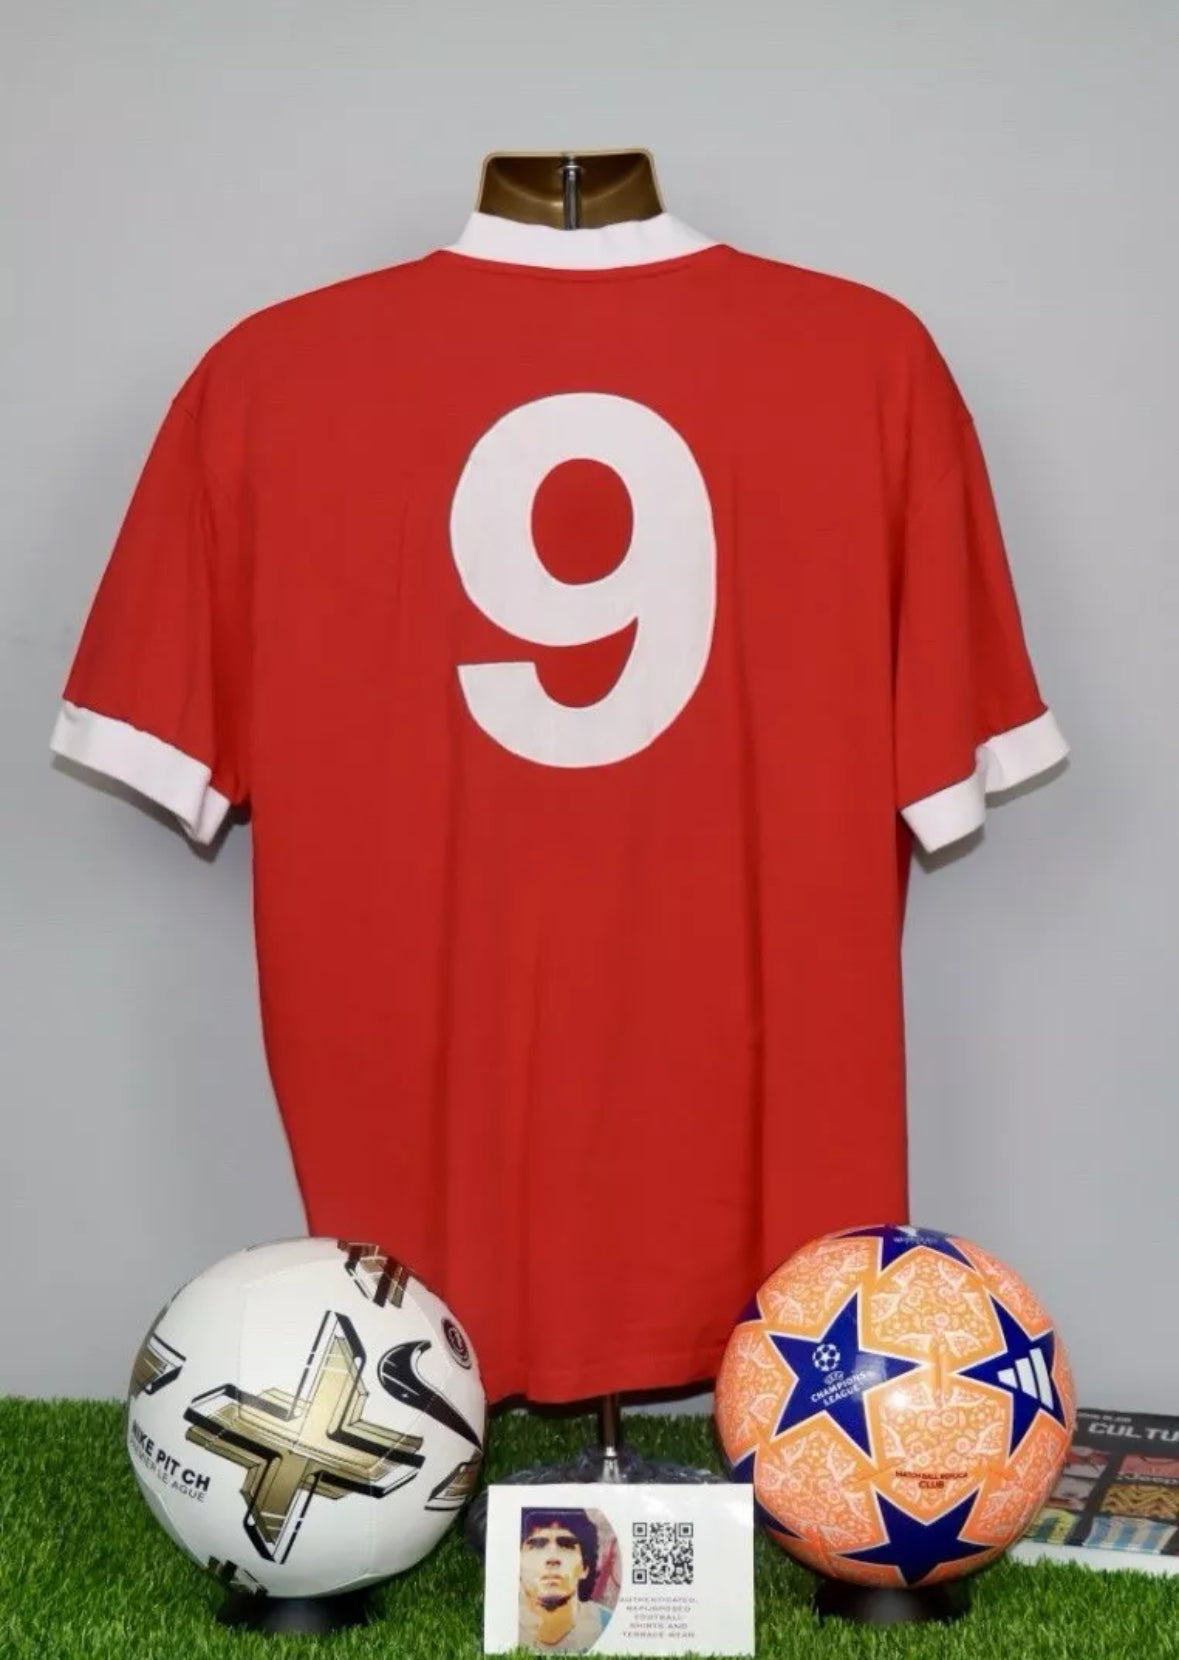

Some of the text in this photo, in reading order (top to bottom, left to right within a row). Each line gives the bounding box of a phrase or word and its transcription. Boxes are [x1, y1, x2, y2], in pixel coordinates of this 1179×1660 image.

[450, 392, 717, 768] 9
[810, 1372, 867, 1403] CHAMPIONS
[823, 1384, 861, 1407] LEAGUE
[131, 1419, 155, 1457] NIKE
[918, 1481, 945, 1489] CLUB
